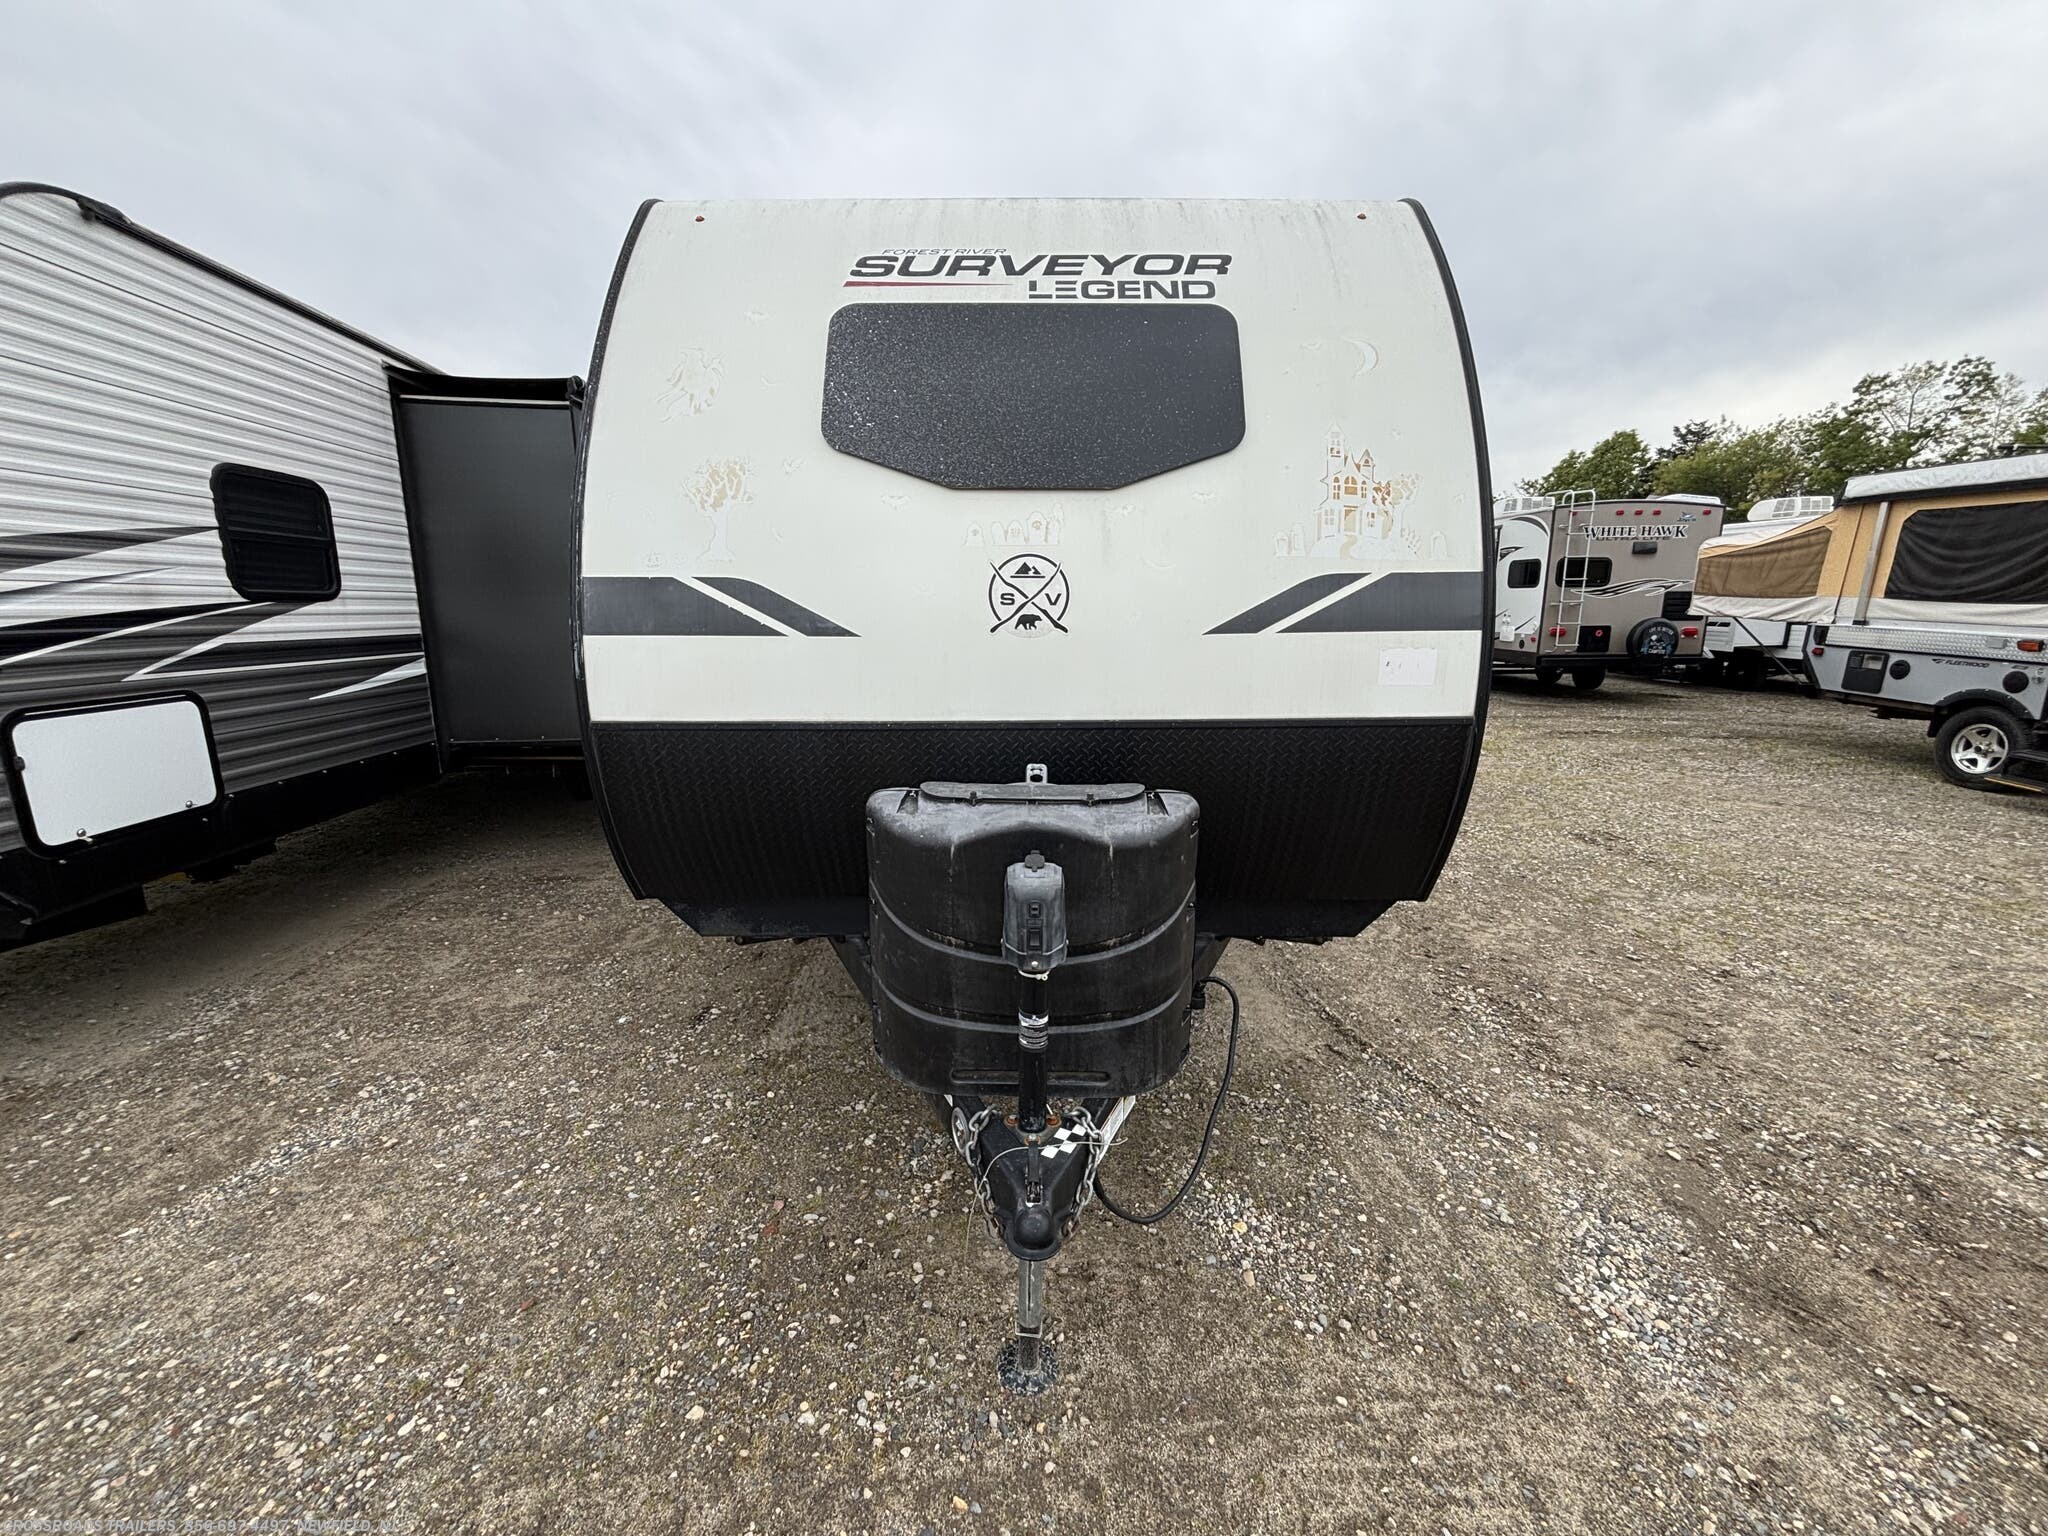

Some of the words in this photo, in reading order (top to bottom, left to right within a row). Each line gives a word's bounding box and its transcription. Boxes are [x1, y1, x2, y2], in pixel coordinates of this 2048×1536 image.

[849, 254, 1232, 277] SURVEYOR
[1028, 280, 1216, 299] LEGEND
[1583, 525, 1637, 539] WHITE
[1640, 525, 1688, 538] HAWK
[1000, 593, 1015, 605] S
[1045, 593, 1061, 605] V
